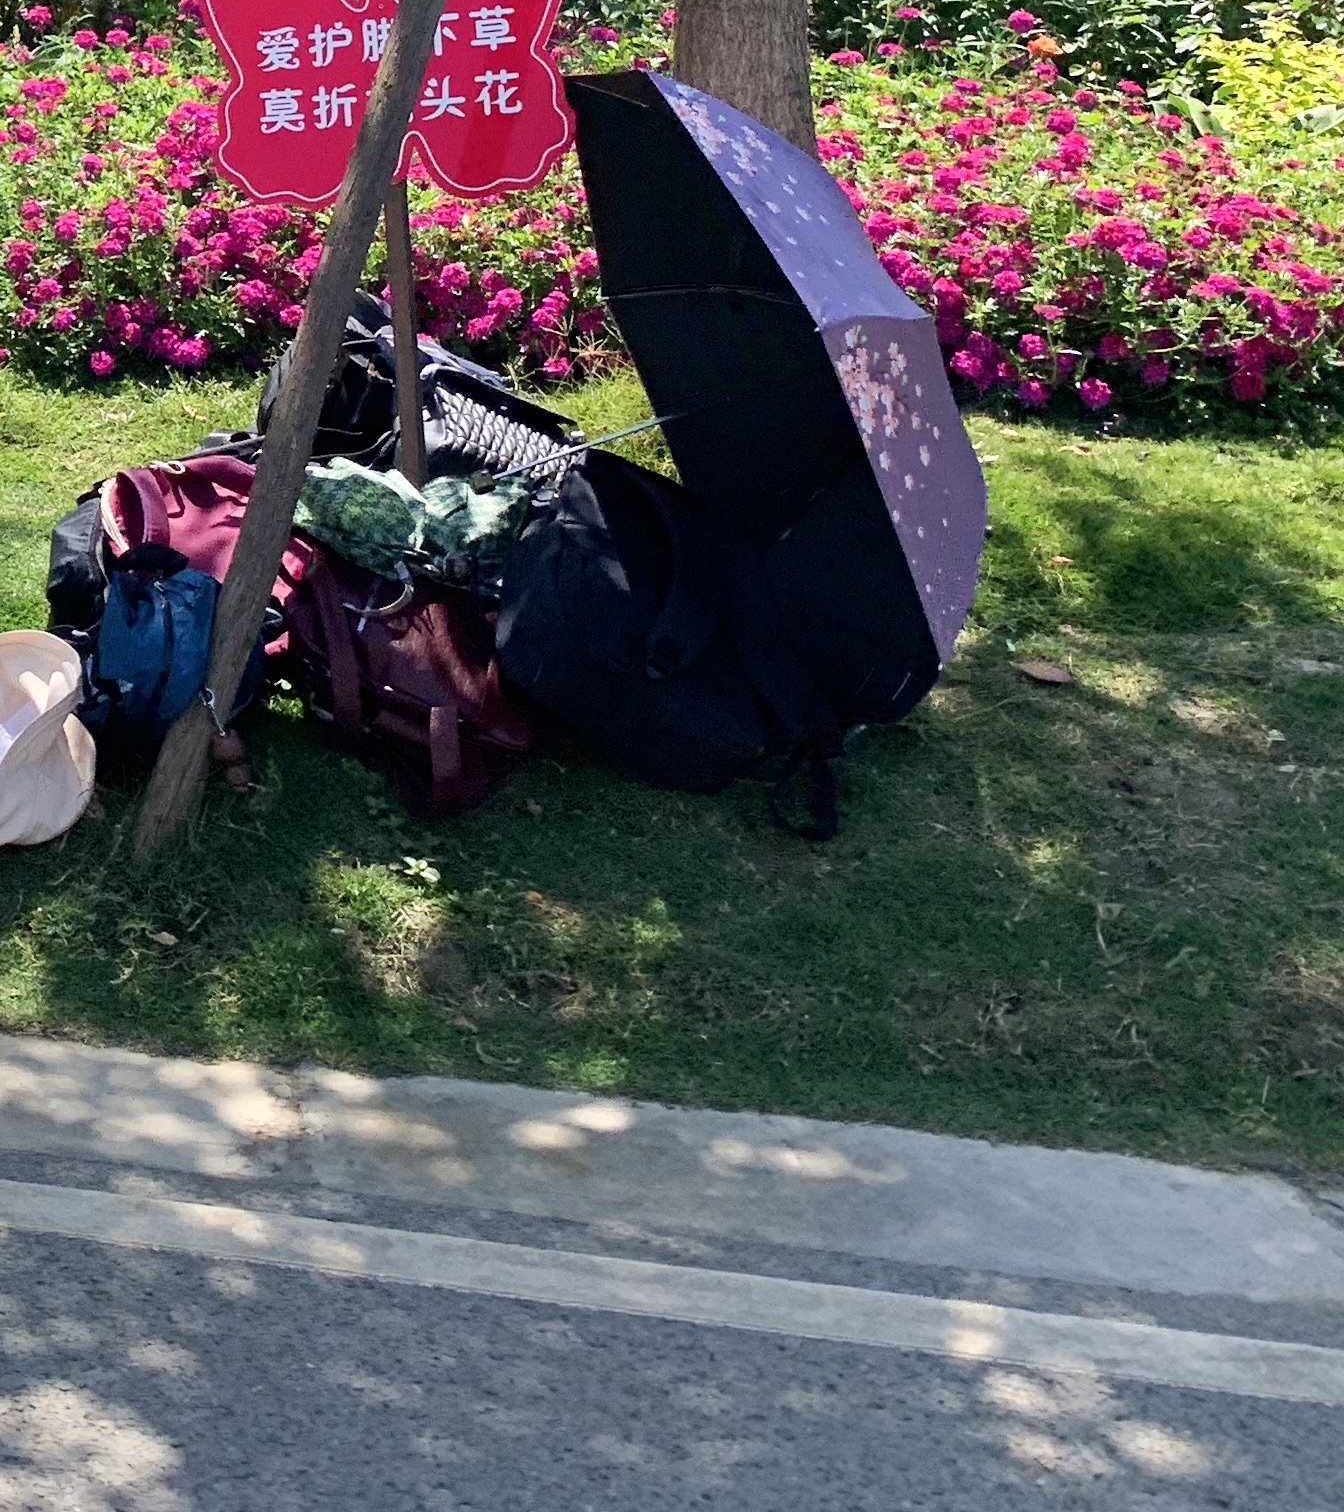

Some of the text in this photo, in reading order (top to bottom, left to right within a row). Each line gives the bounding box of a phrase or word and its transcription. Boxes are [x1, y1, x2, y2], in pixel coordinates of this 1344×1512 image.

[256, 4, 517, 73] 爱护脚下草
[259, 68, 523, 135] 莫折头花
